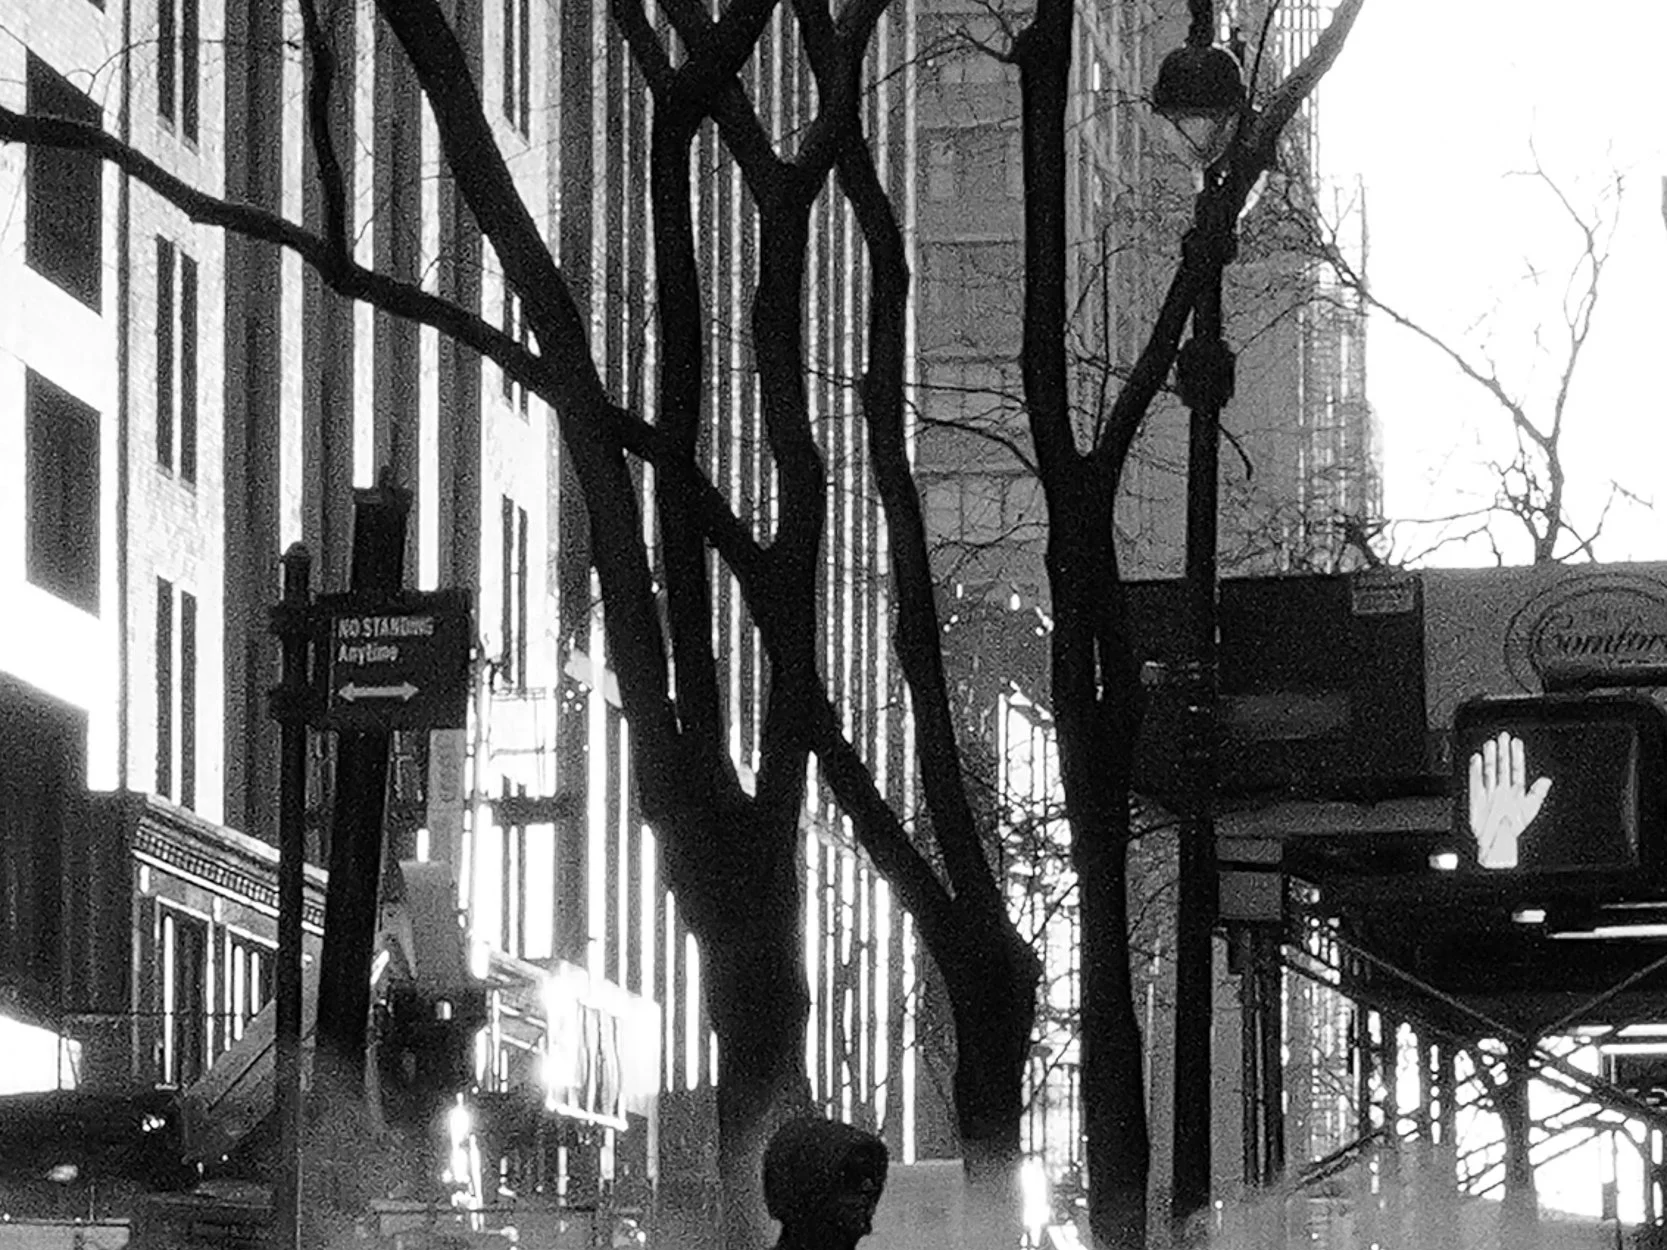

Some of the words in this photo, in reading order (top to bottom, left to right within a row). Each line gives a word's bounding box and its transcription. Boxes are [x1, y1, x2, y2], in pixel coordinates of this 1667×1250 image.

[338, 617, 360, 638] NO
[362, 616, 434, 637] STANDING
[1535, 612, 1667, 655] Comfor
[338, 642, 399, 665] Anytime
